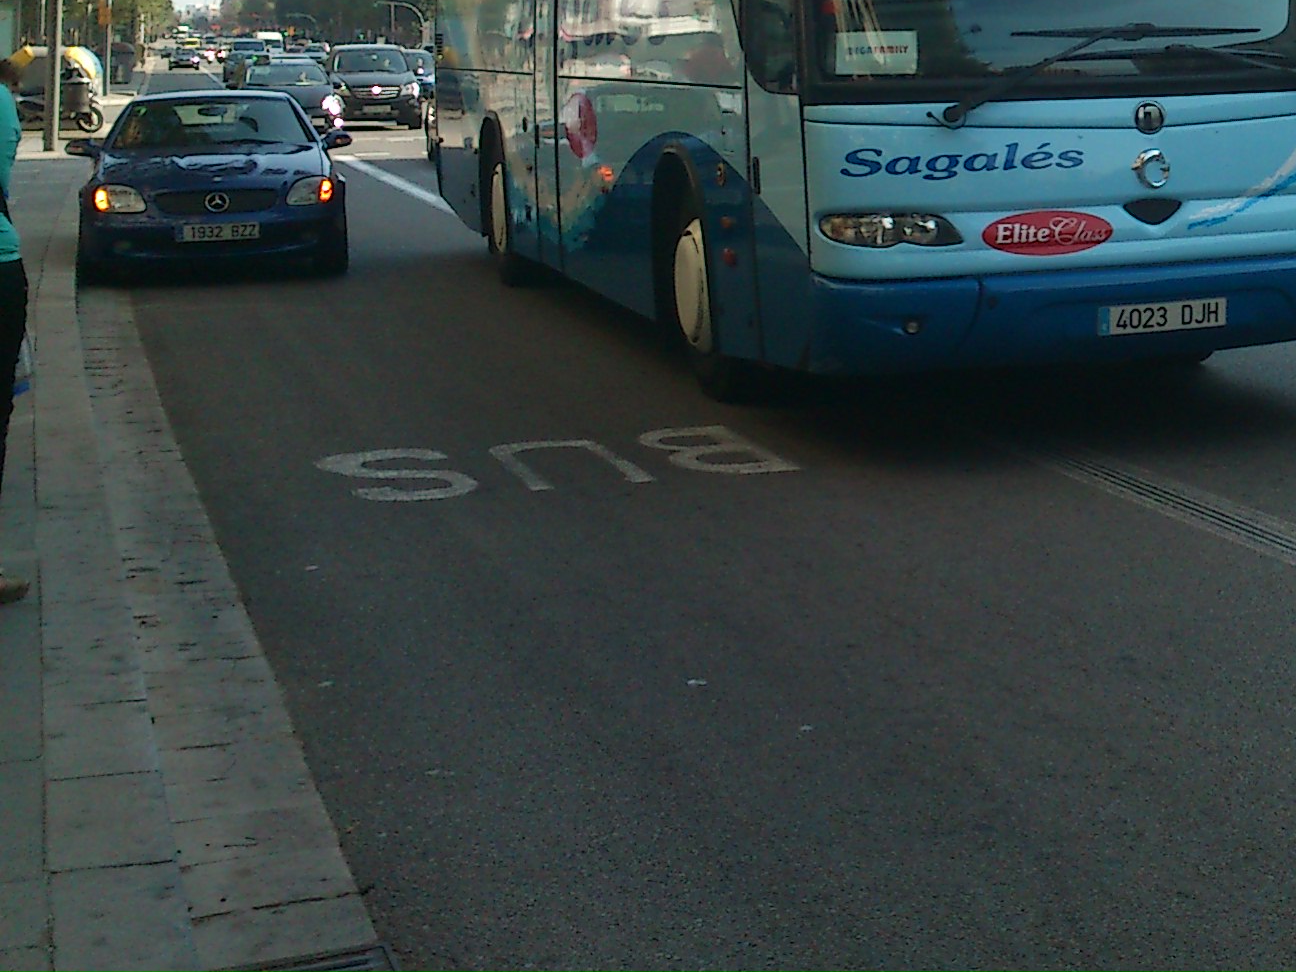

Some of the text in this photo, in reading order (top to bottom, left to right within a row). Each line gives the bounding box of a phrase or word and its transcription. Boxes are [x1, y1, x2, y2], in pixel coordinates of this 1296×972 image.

[839, 142, 1085, 181] Sagalés
[191, 225, 223, 240] 1932
[995, 216, 1108, 246] Elite Class
[1115, 302, 1219, 329] 4023 DJH
[313, 424, 802, 502] BUS
